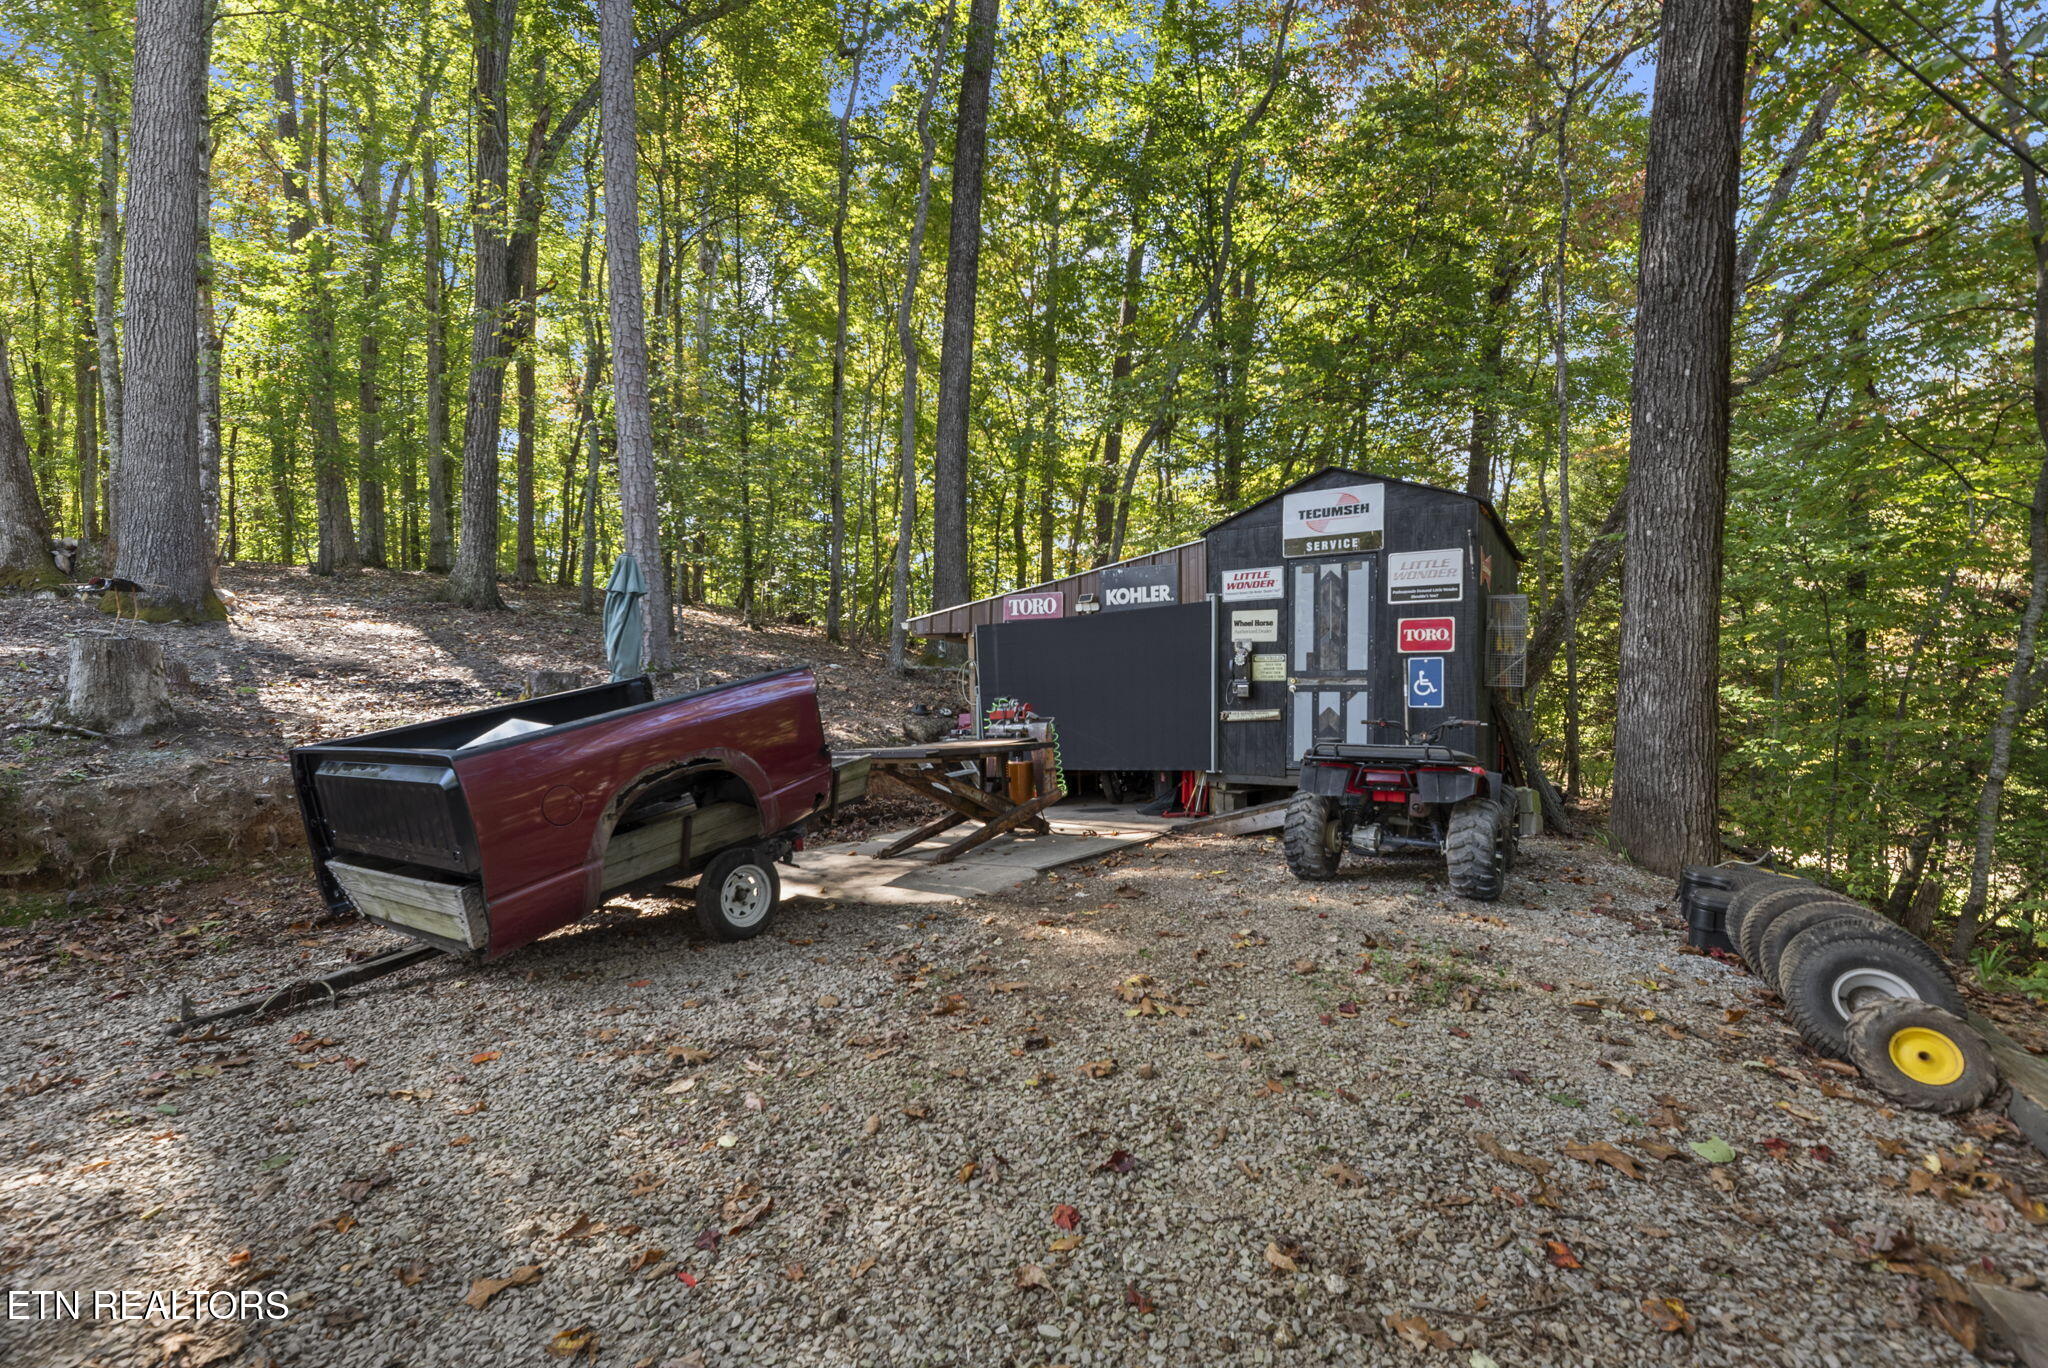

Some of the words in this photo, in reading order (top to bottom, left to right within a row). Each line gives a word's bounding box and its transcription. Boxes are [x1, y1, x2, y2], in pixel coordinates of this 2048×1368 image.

[1298, 502, 1370, 520] TECUMSEH
[1306, 537, 1359, 552] SERVICE
[1400, 558, 1450, 570] LITTLE
[1233, 570, 1271, 581] LITTLE
[1393, 567, 1458, 581] WONDER
[1226, 579, 1275, 590] WONDER
[1008, 597, 1057, 616] TORO
[1234, 619, 1254, 627] Wheel
[1254, 619, 1274, 627] Horse
[1403, 627, 1450, 642] TORO
